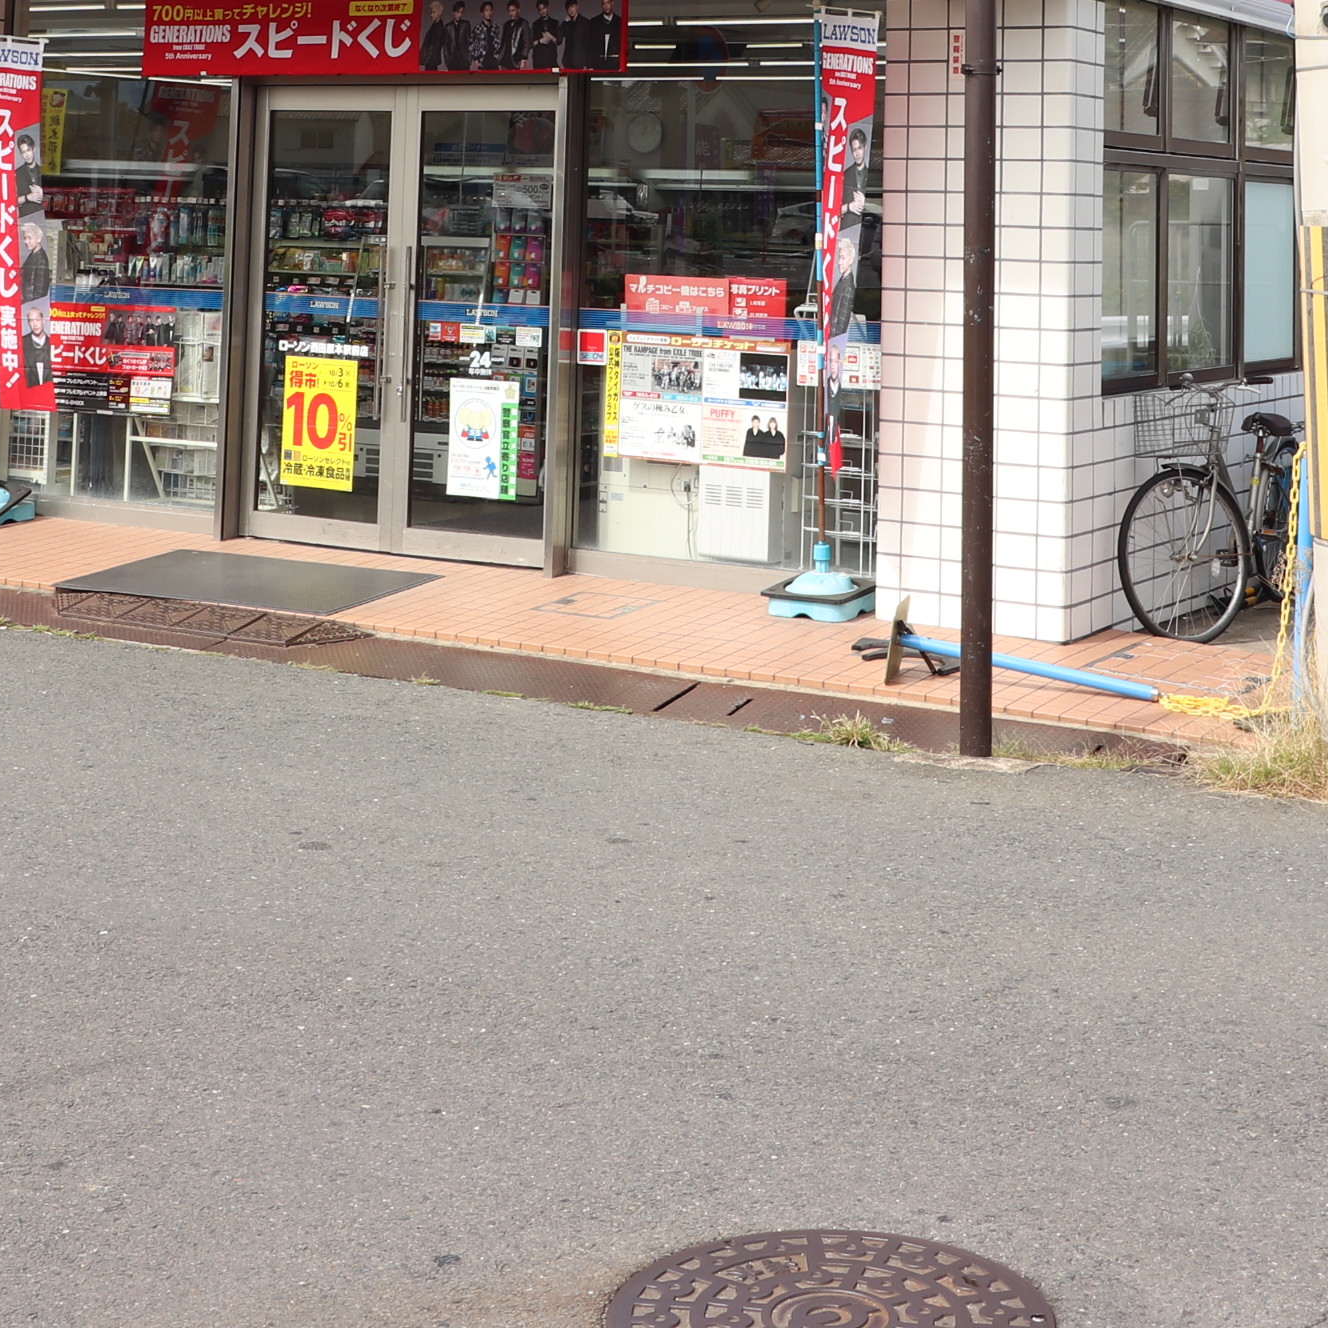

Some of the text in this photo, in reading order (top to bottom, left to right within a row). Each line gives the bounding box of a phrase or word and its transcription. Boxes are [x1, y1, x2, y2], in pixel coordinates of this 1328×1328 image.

[150, 25, 231, 43] GENERATIONS
[233, 18, 412, 60] スピードくじ
[823, 23, 876, 45] LAWSON
[165, 52, 212, 61] 5th Anniversary
[823, 52, 874, 75] GENERATIONS
[629, 283, 725, 297] マルチコピー機はこちら
[730, 284, 780, 297] 写真プリント
[310, 301, 339, 309] LAWSON
[50, 345, 107, 365] ピードくじ
[634, 346, 658, 354] RAMPAGE
[659, 347, 671, 355] from
[292, 361, 318, 370] ローソン
[469, 350, 491, 368] 24
[711, 409, 735, 418] PUFFY
